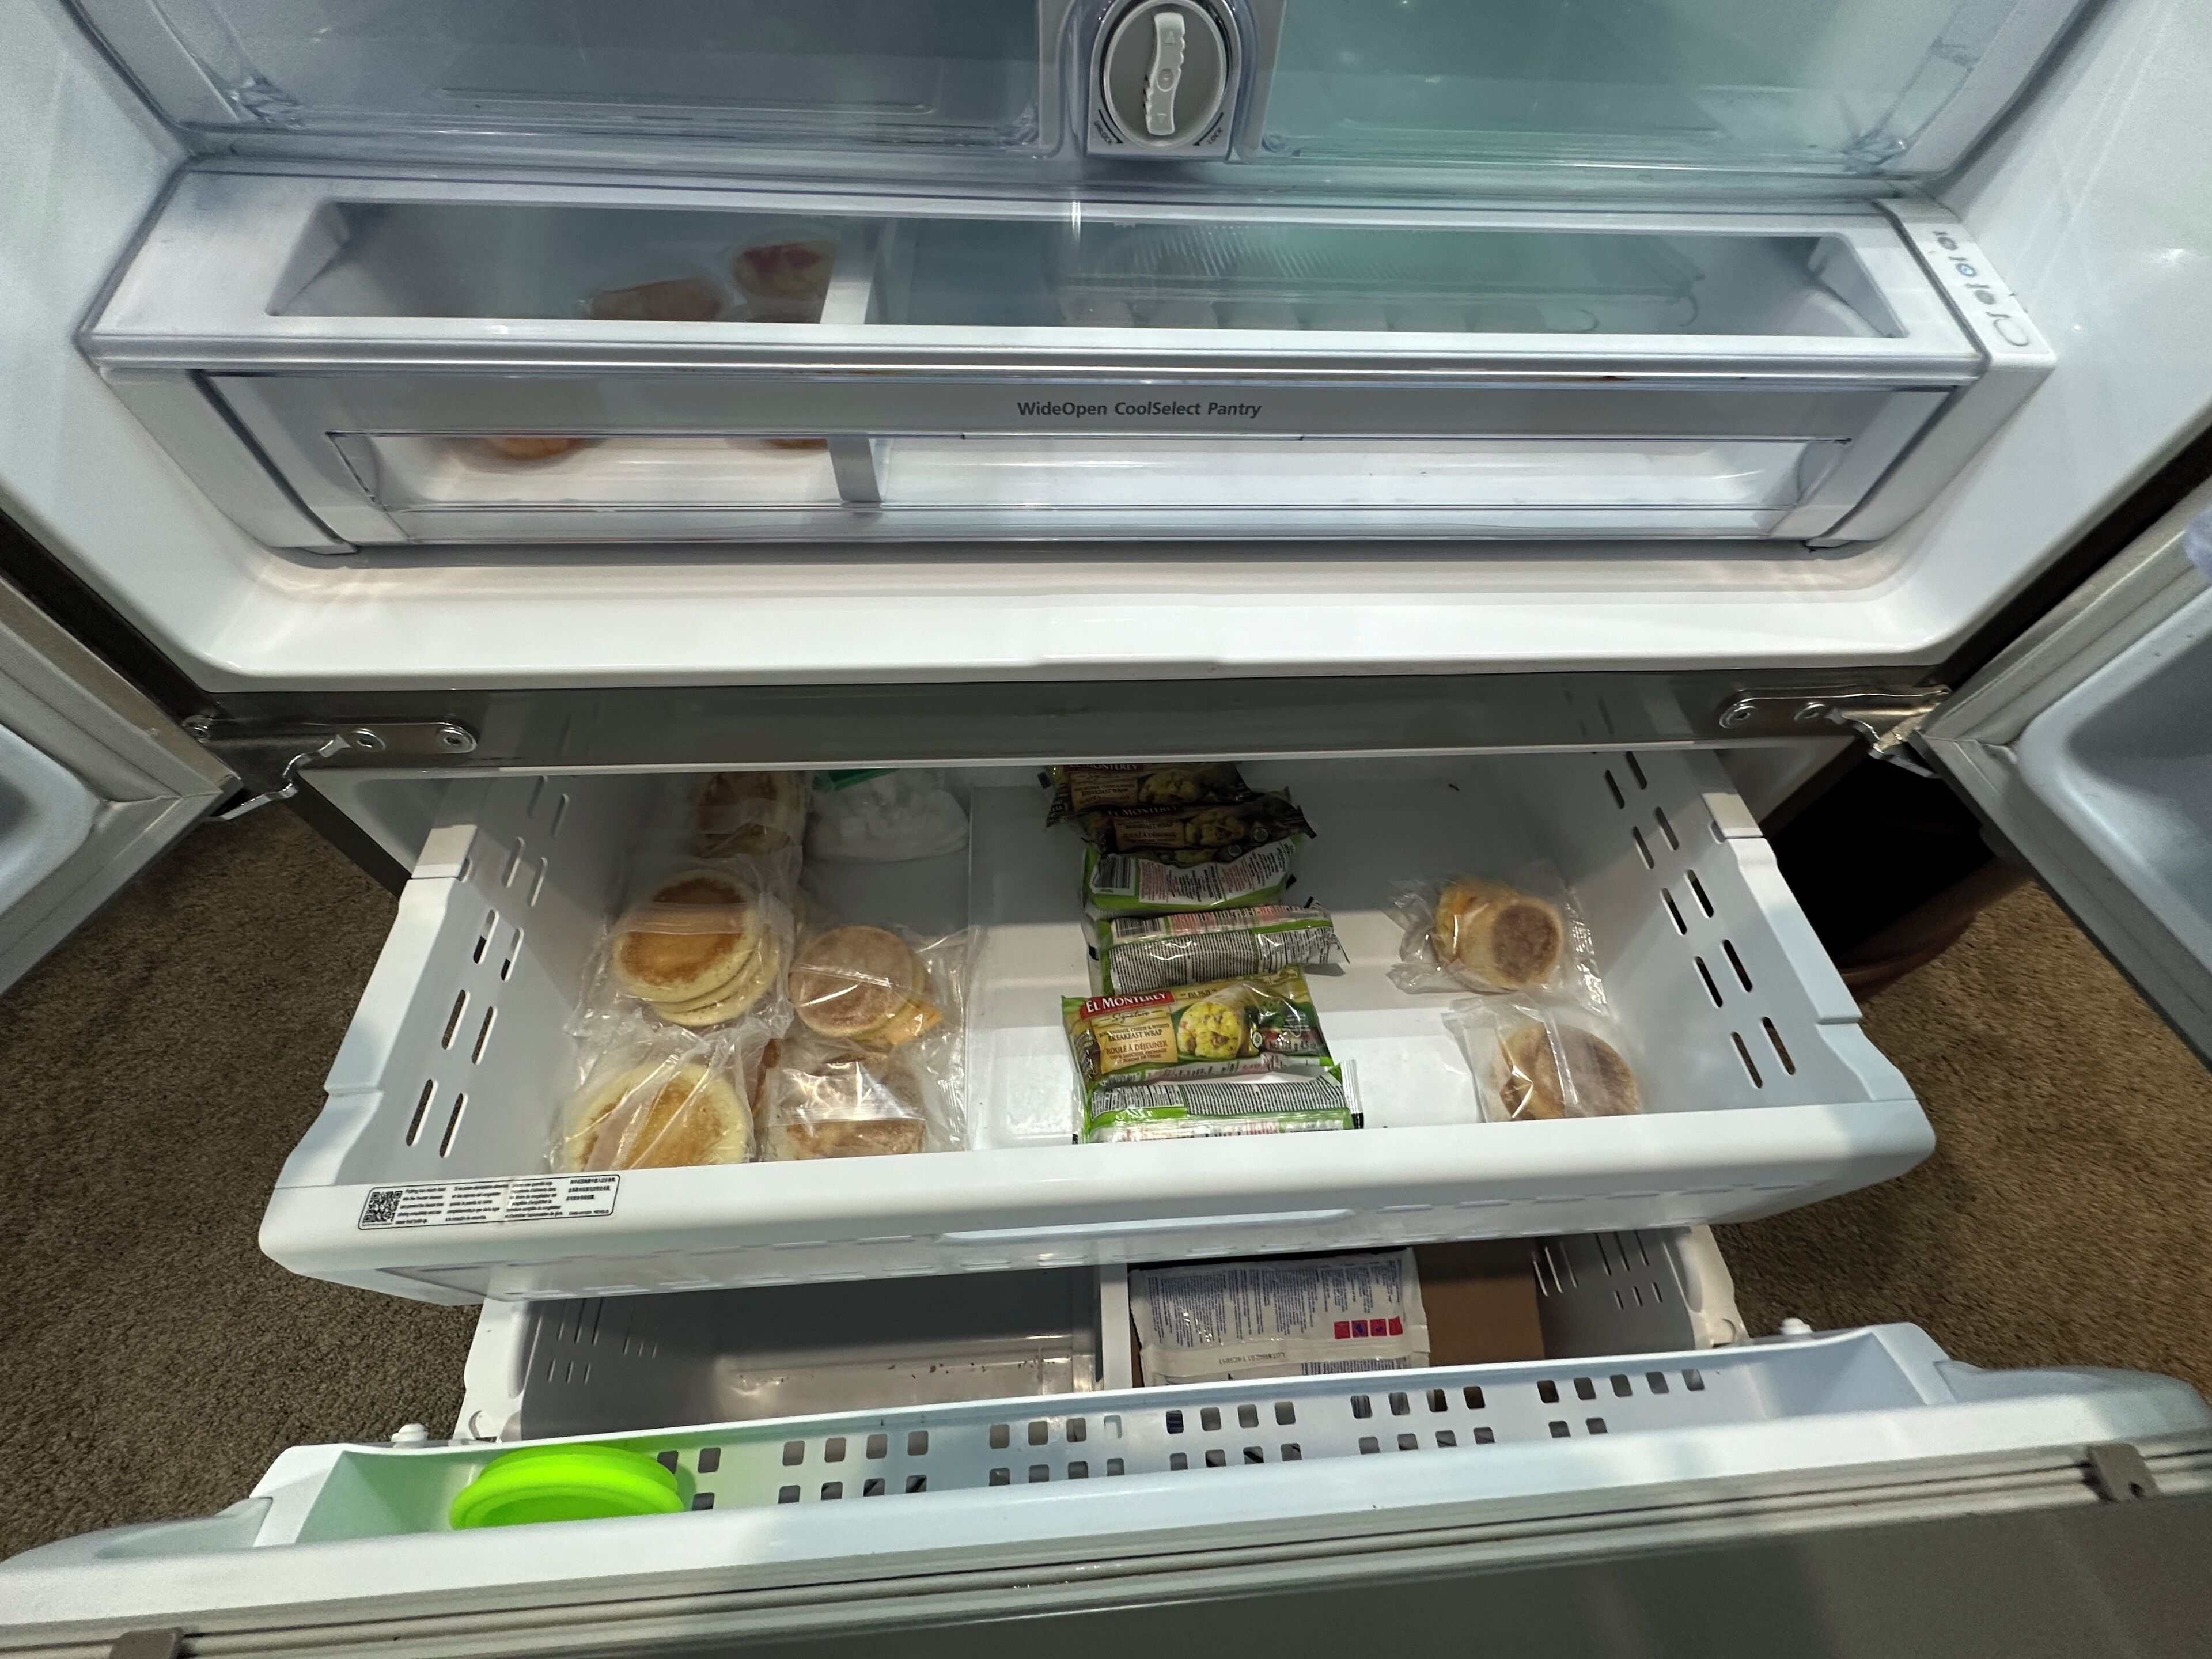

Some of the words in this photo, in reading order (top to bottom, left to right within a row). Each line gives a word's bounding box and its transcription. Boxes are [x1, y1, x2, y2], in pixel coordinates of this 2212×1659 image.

[1094, 120, 1113, 144] UNLOCK
[1208, 127, 1223, 145] LOCK
[1017, 402, 1107, 417] WideOpen
[1115, 402, 1200, 415] CoolSelect
[1208, 402, 1262, 418] Pantry
[1086, 1000, 1101, 1013] EL
[1103, 992, 1166, 1009] MONTEREY
[1111, 1010, 1150, 1024] Signature
[1108, 1031, 1143, 1042] BREAKFAST
[1143, 1029, 1162, 1037] WRAP
[1106, 1044, 1127, 1055] ROULÉ
[1128, 1043, 1134, 1051] À
[1135, 1040, 1168, 1051] DÉJEUNER
